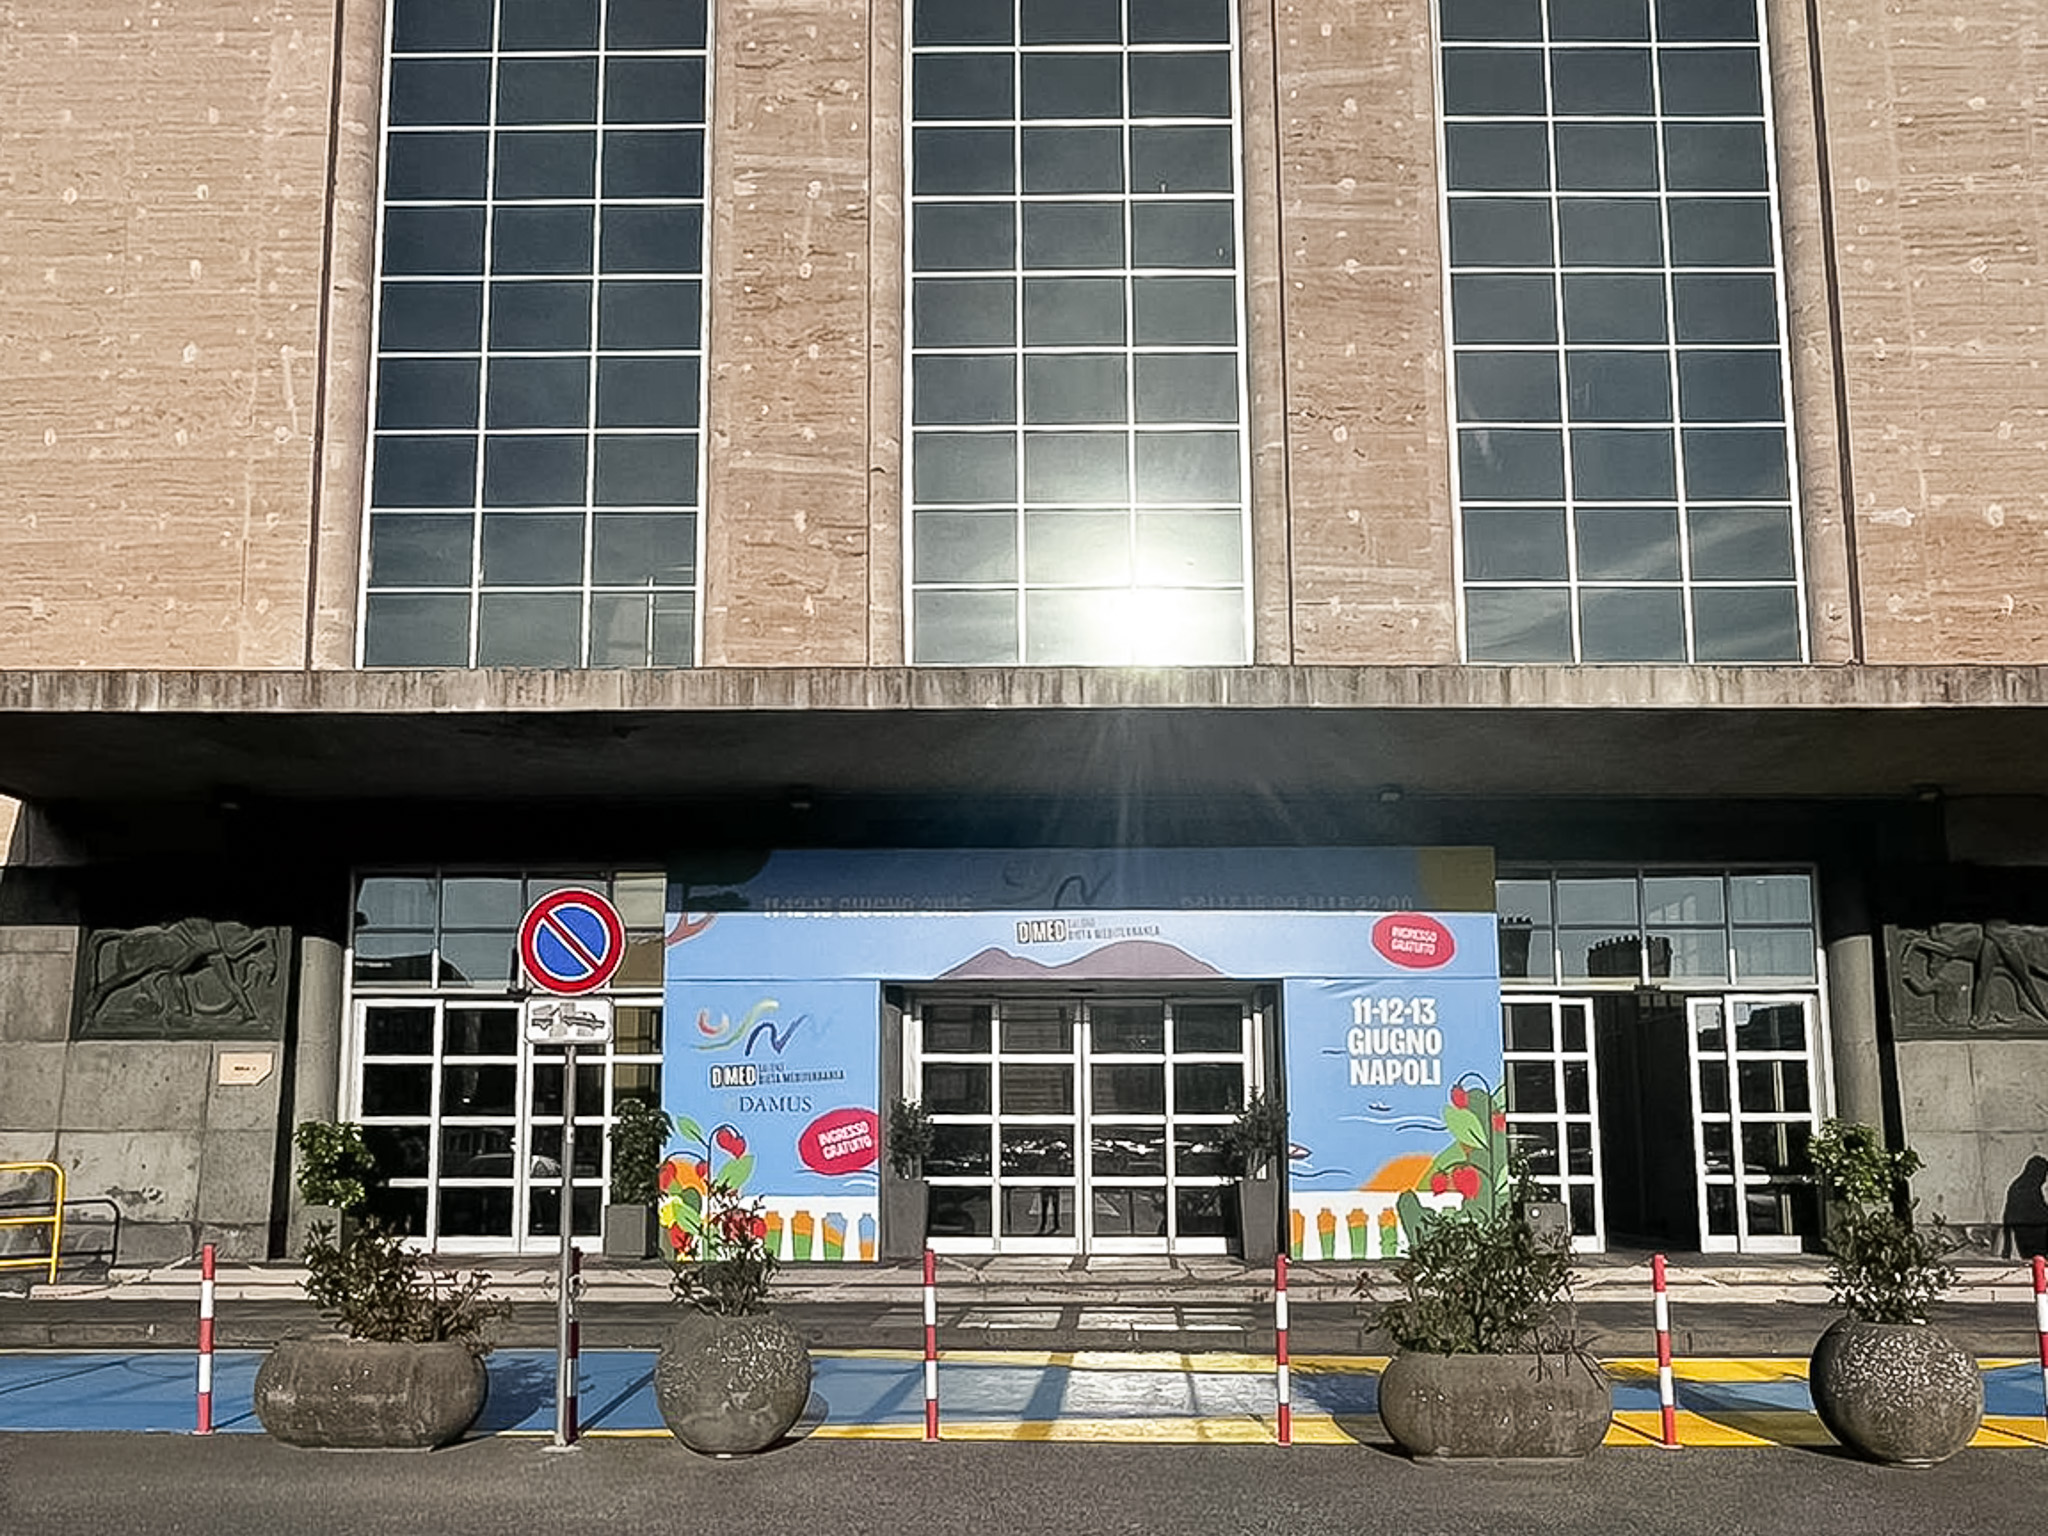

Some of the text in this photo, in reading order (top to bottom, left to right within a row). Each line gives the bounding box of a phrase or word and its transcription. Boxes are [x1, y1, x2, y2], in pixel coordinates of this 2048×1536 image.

[1352, 997, 1437, 1025] 11-12-13
[1347, 1027, 1443, 1056] GIUGNO
[1350, 1058, 1441, 1086] NAPOLI
[740, 1096, 813, 1113] DAMUS
